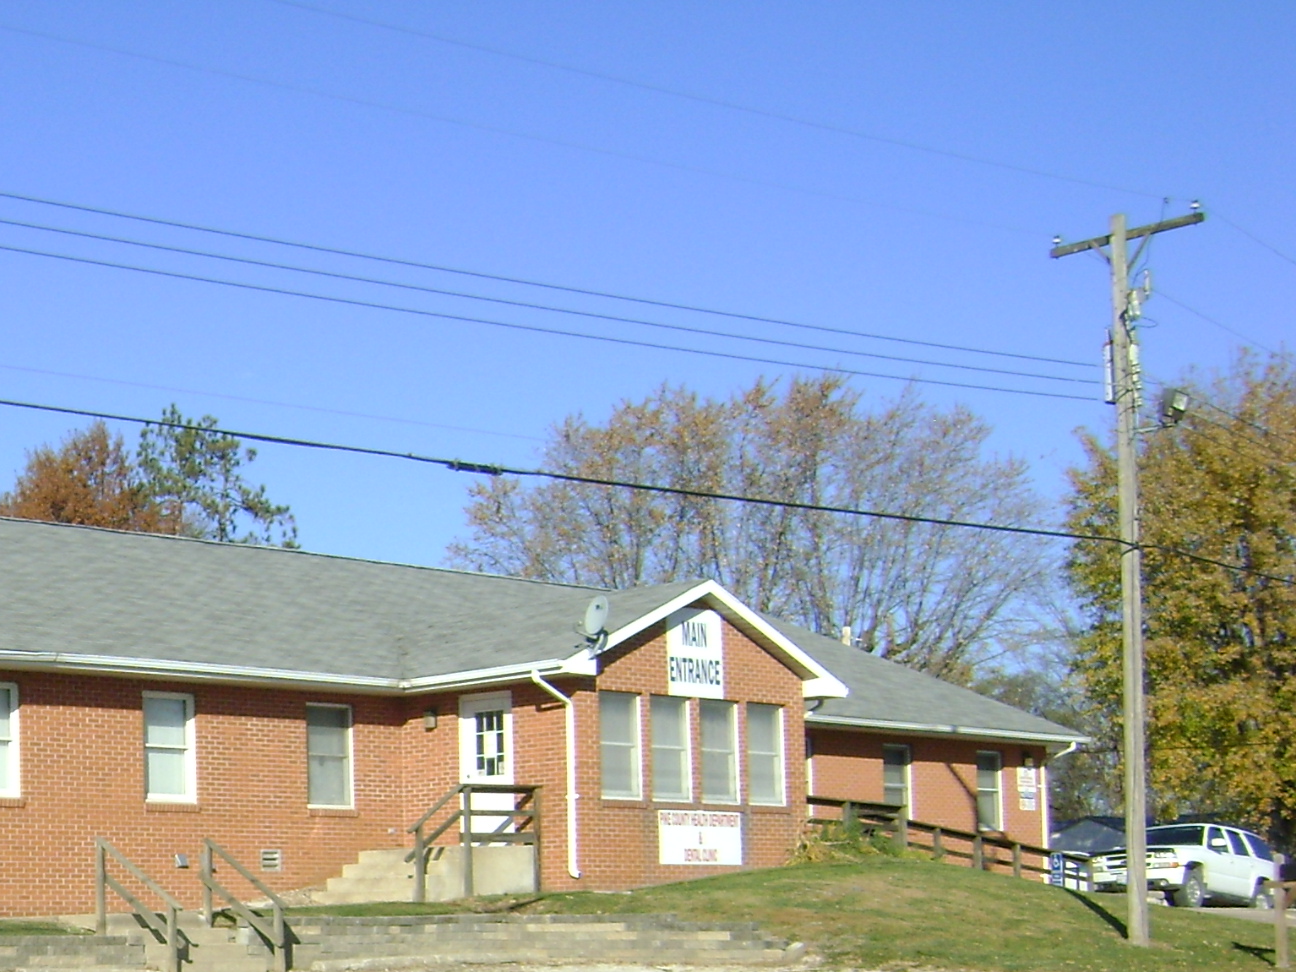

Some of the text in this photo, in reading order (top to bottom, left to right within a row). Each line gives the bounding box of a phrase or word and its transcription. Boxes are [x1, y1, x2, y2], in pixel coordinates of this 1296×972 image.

[681, 621, 707, 648] MAIN
[670, 656, 721, 685] ENTRANCE
[672, 813, 691, 826] COUNTY
[691, 813, 709, 827] HEALTH
[709, 814, 739, 828] DEPARTMENT
[684, 848, 718, 862] DENTAL CLINIC
